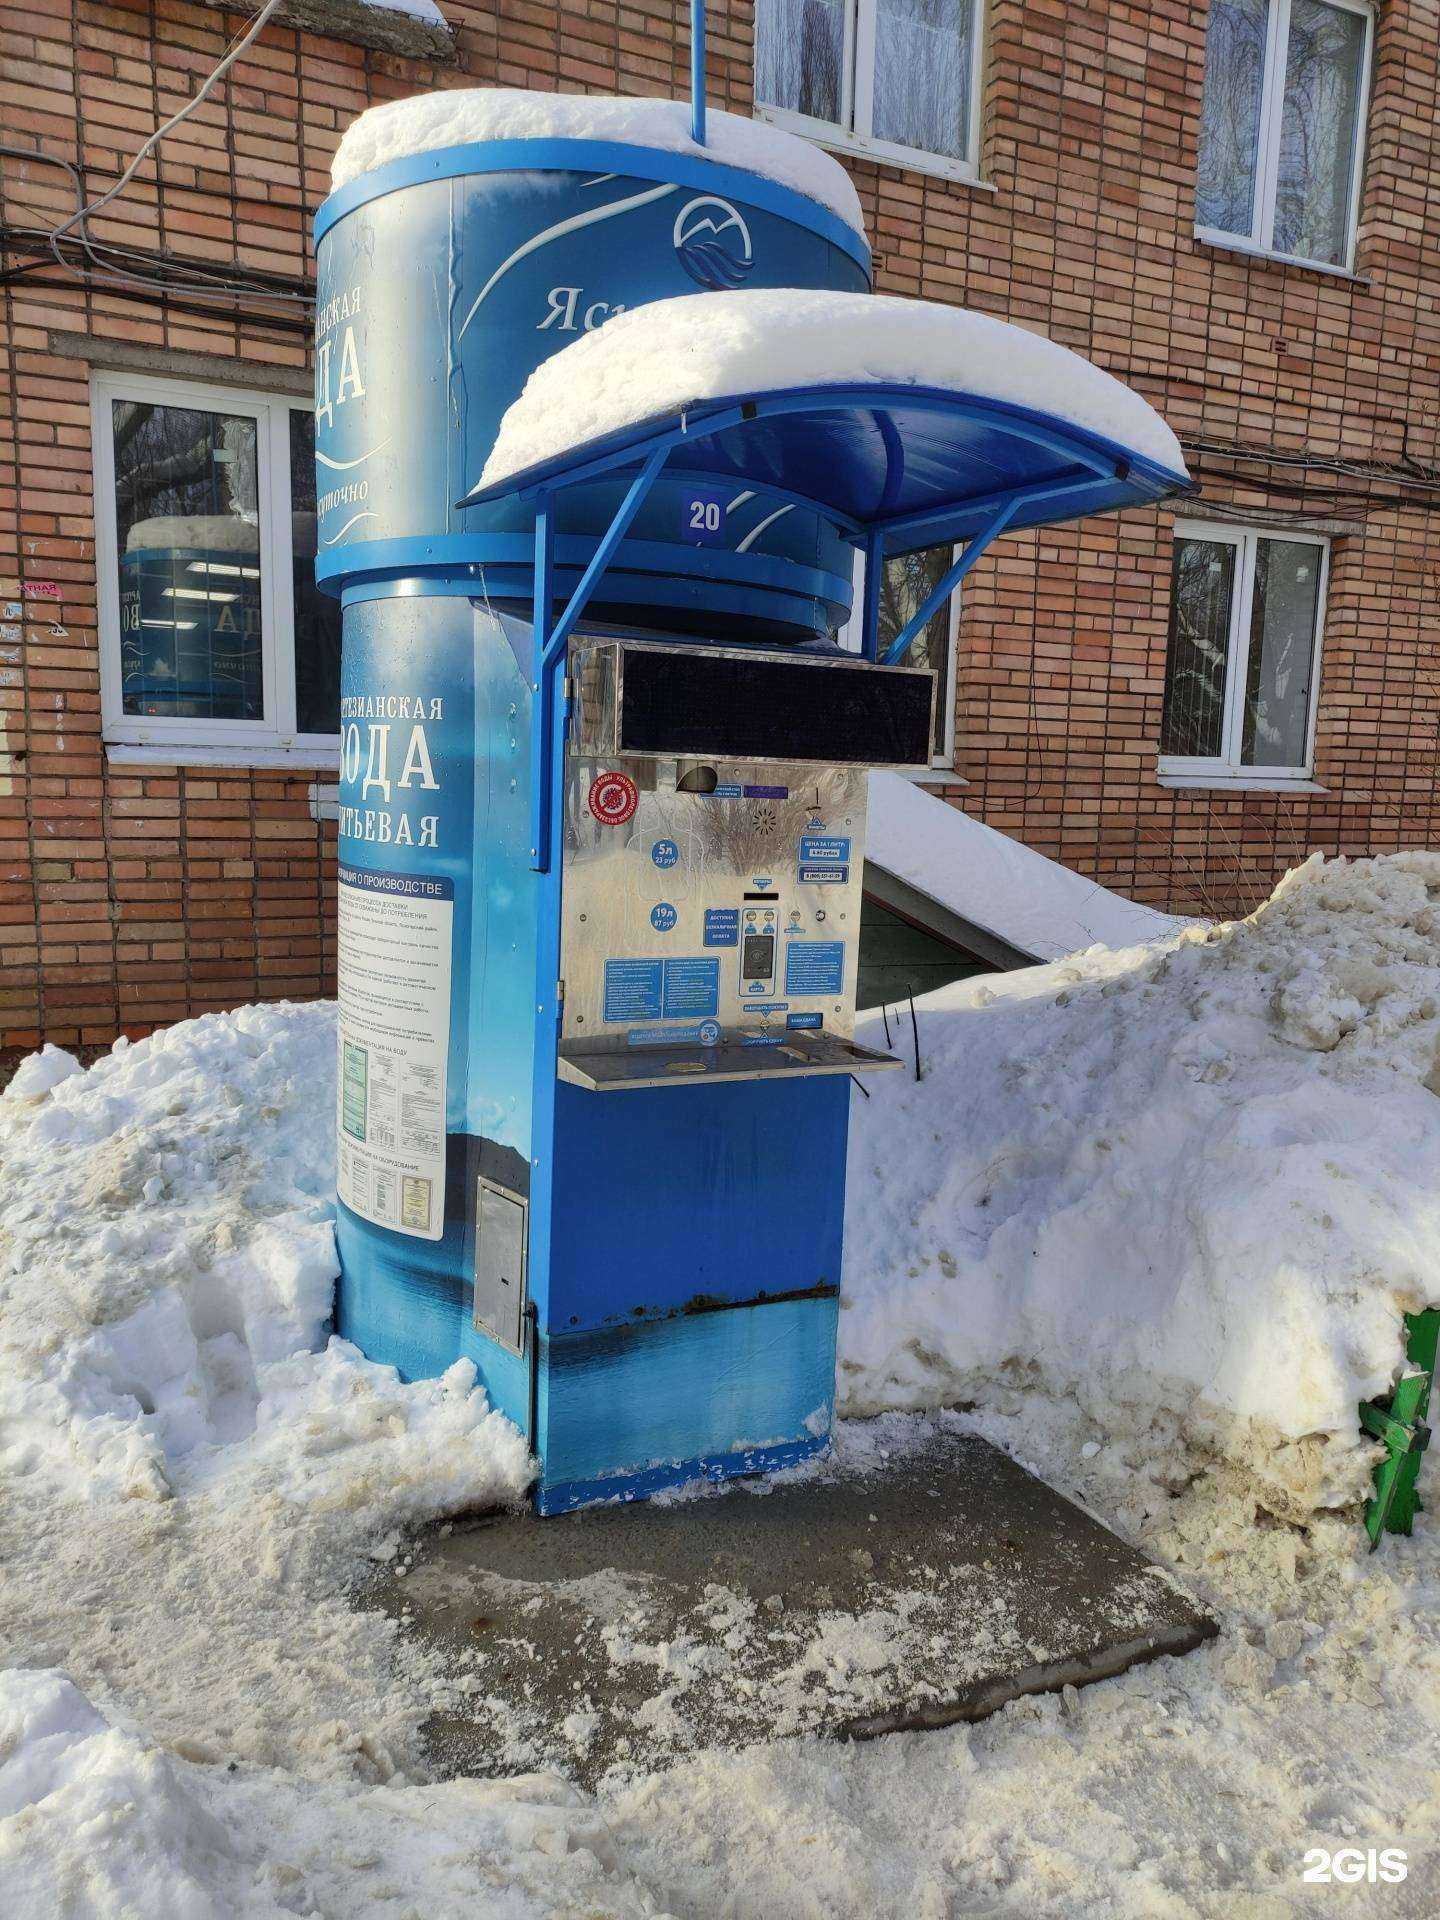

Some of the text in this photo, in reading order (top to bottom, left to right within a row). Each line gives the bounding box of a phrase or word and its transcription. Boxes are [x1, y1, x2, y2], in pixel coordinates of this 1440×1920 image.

[690, 501, 720, 531] 20
[658, 844, 673, 855] 5л
[363, 873, 443, 895] ПРОИЗВОДСТВЕ
[656, 908, 673, 918] 19л
[393, 1048, 408, 1057] ВОДУ
